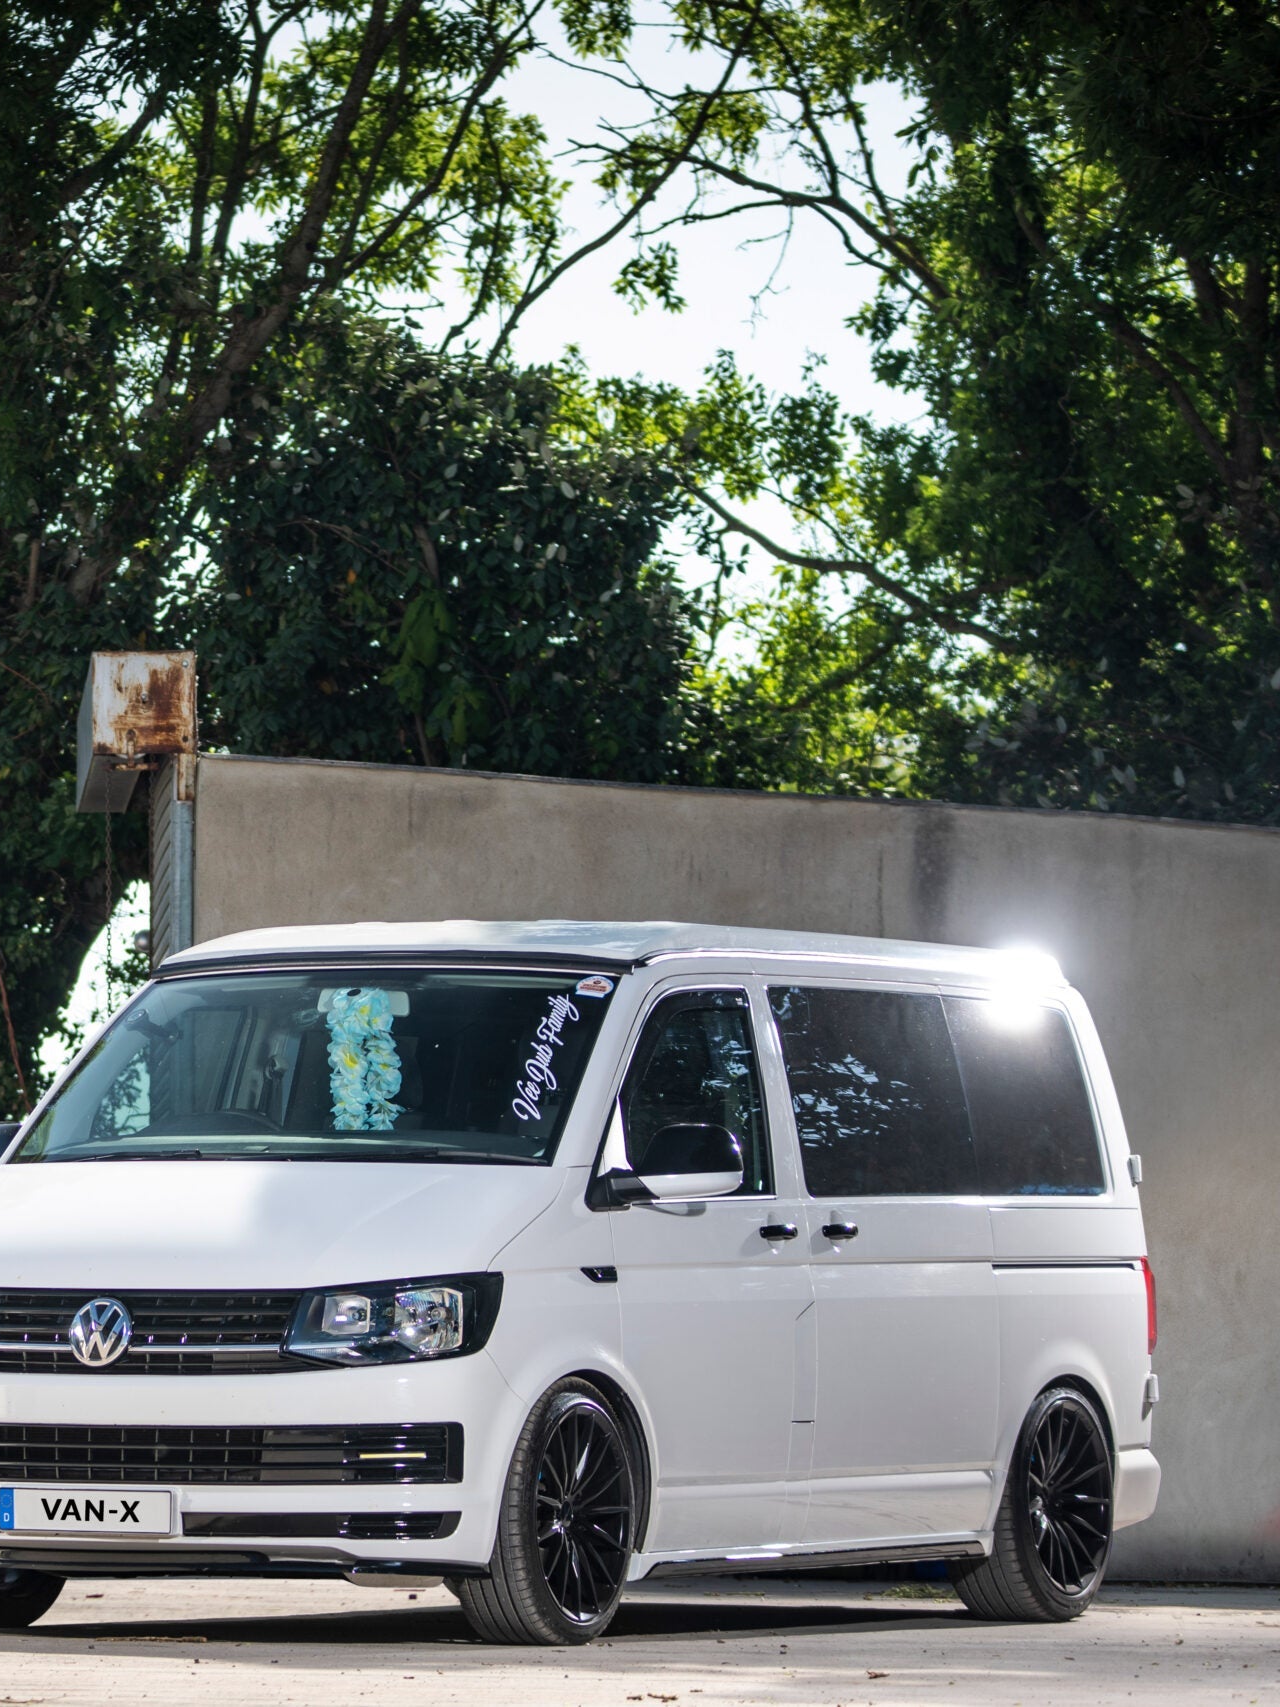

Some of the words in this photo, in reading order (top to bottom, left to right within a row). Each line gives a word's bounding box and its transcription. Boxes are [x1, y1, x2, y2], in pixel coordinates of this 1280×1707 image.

[536, 994, 580, 1046] Family
[525, 1042, 557, 1091] Dub
[512, 1080, 541, 1120] Vee
[3, 1512, 10, 1522] D
[40, 1498, 140, 1523] VAN-X
